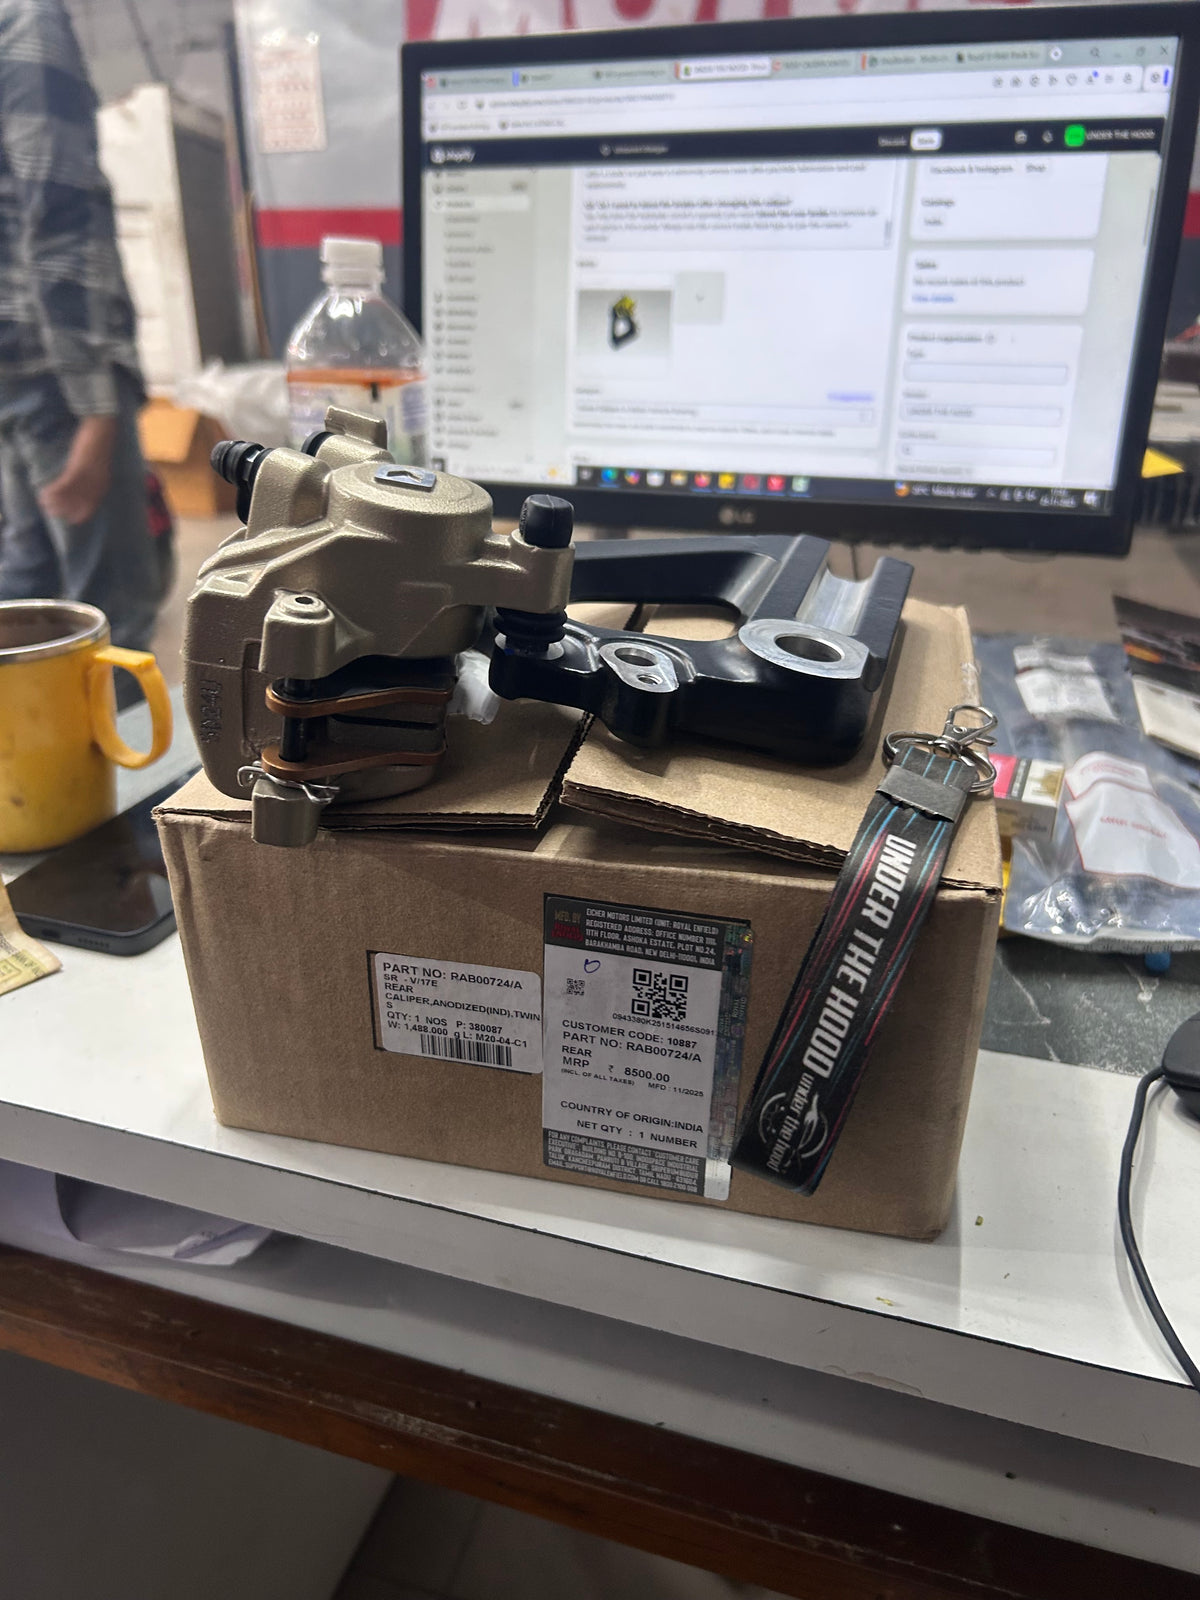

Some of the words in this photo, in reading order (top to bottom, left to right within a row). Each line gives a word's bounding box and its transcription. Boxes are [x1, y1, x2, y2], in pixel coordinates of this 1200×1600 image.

[861, 834, 916, 930] UNDER
[586, 919, 622, 931] REGISTERED
[656, 930, 676, 939] OFFICE
[678, 933, 703, 943] NUMBER
[587, 908, 605, 918] EICHER
[607, 911, 629, 922] MOTORS
[631, 915, 653, 925] LIMITED
[673, 921, 692, 931] ROYAL
[585, 939, 624, 953] BARAKHAMBA
[645, 948, 657, 957] NEW
[623, 935, 647, 944] ASHOKA
[678, 943, 693, 951] PLOT
[836, 928, 884, 994] THE
[383, 963, 418, 975] PART
[423, 968, 446, 979] NO:
[451, 972, 522, 989] RAB00724/A
[384, 974, 398, 982] SR
[410, 977, 437, 987] V/17E
[385, 983, 413, 993] REAR
[387, 1012, 411, 1021] QTY:
[426, 1016, 447, 1026] NOS
[456, 1021, 466, 1029] P:
[469, 1023, 502, 1034] 380087
[388, 1021, 400, 1029] W:
[463, 1032, 472, 1040] L:
[476, 1034, 527, 1047] M20-04-C1
[563, 1019, 625, 1036] CUSTOMER
[629, 1031, 664, 1043] CODE:
[668, 1037, 697, 1048] 10887
[802, 986, 859, 1078] HOOD
[562, 1046, 592, 1057] REAR
[563, 1031, 596, 1044] PART
[600, 1037, 622, 1048] NO:
[627, 1042, 702, 1062] RAB00724/A
[563, 1056, 590, 1068] MRP
[625, 1067, 670, 1082] 8500.00
[609, 1076, 635, 1086] TAXES)
[648, 1083, 666, 1091] MFD
[674, 1087, 703, 1097] 11/2025
[790, 1072, 814, 1114] under
[561, 1101, 612, 1116] COUNTRY
[616, 1111, 630, 1119] OF
[633, 1113, 703, 1133] ORIGIN:INDIA
[780, 1116, 800, 1140] the
[577, 1120, 598, 1130] NET
[601, 1125, 622, 1135] QTY
[651, 1133, 697, 1148] NUMBER
[766, 1139, 790, 1172] hood
